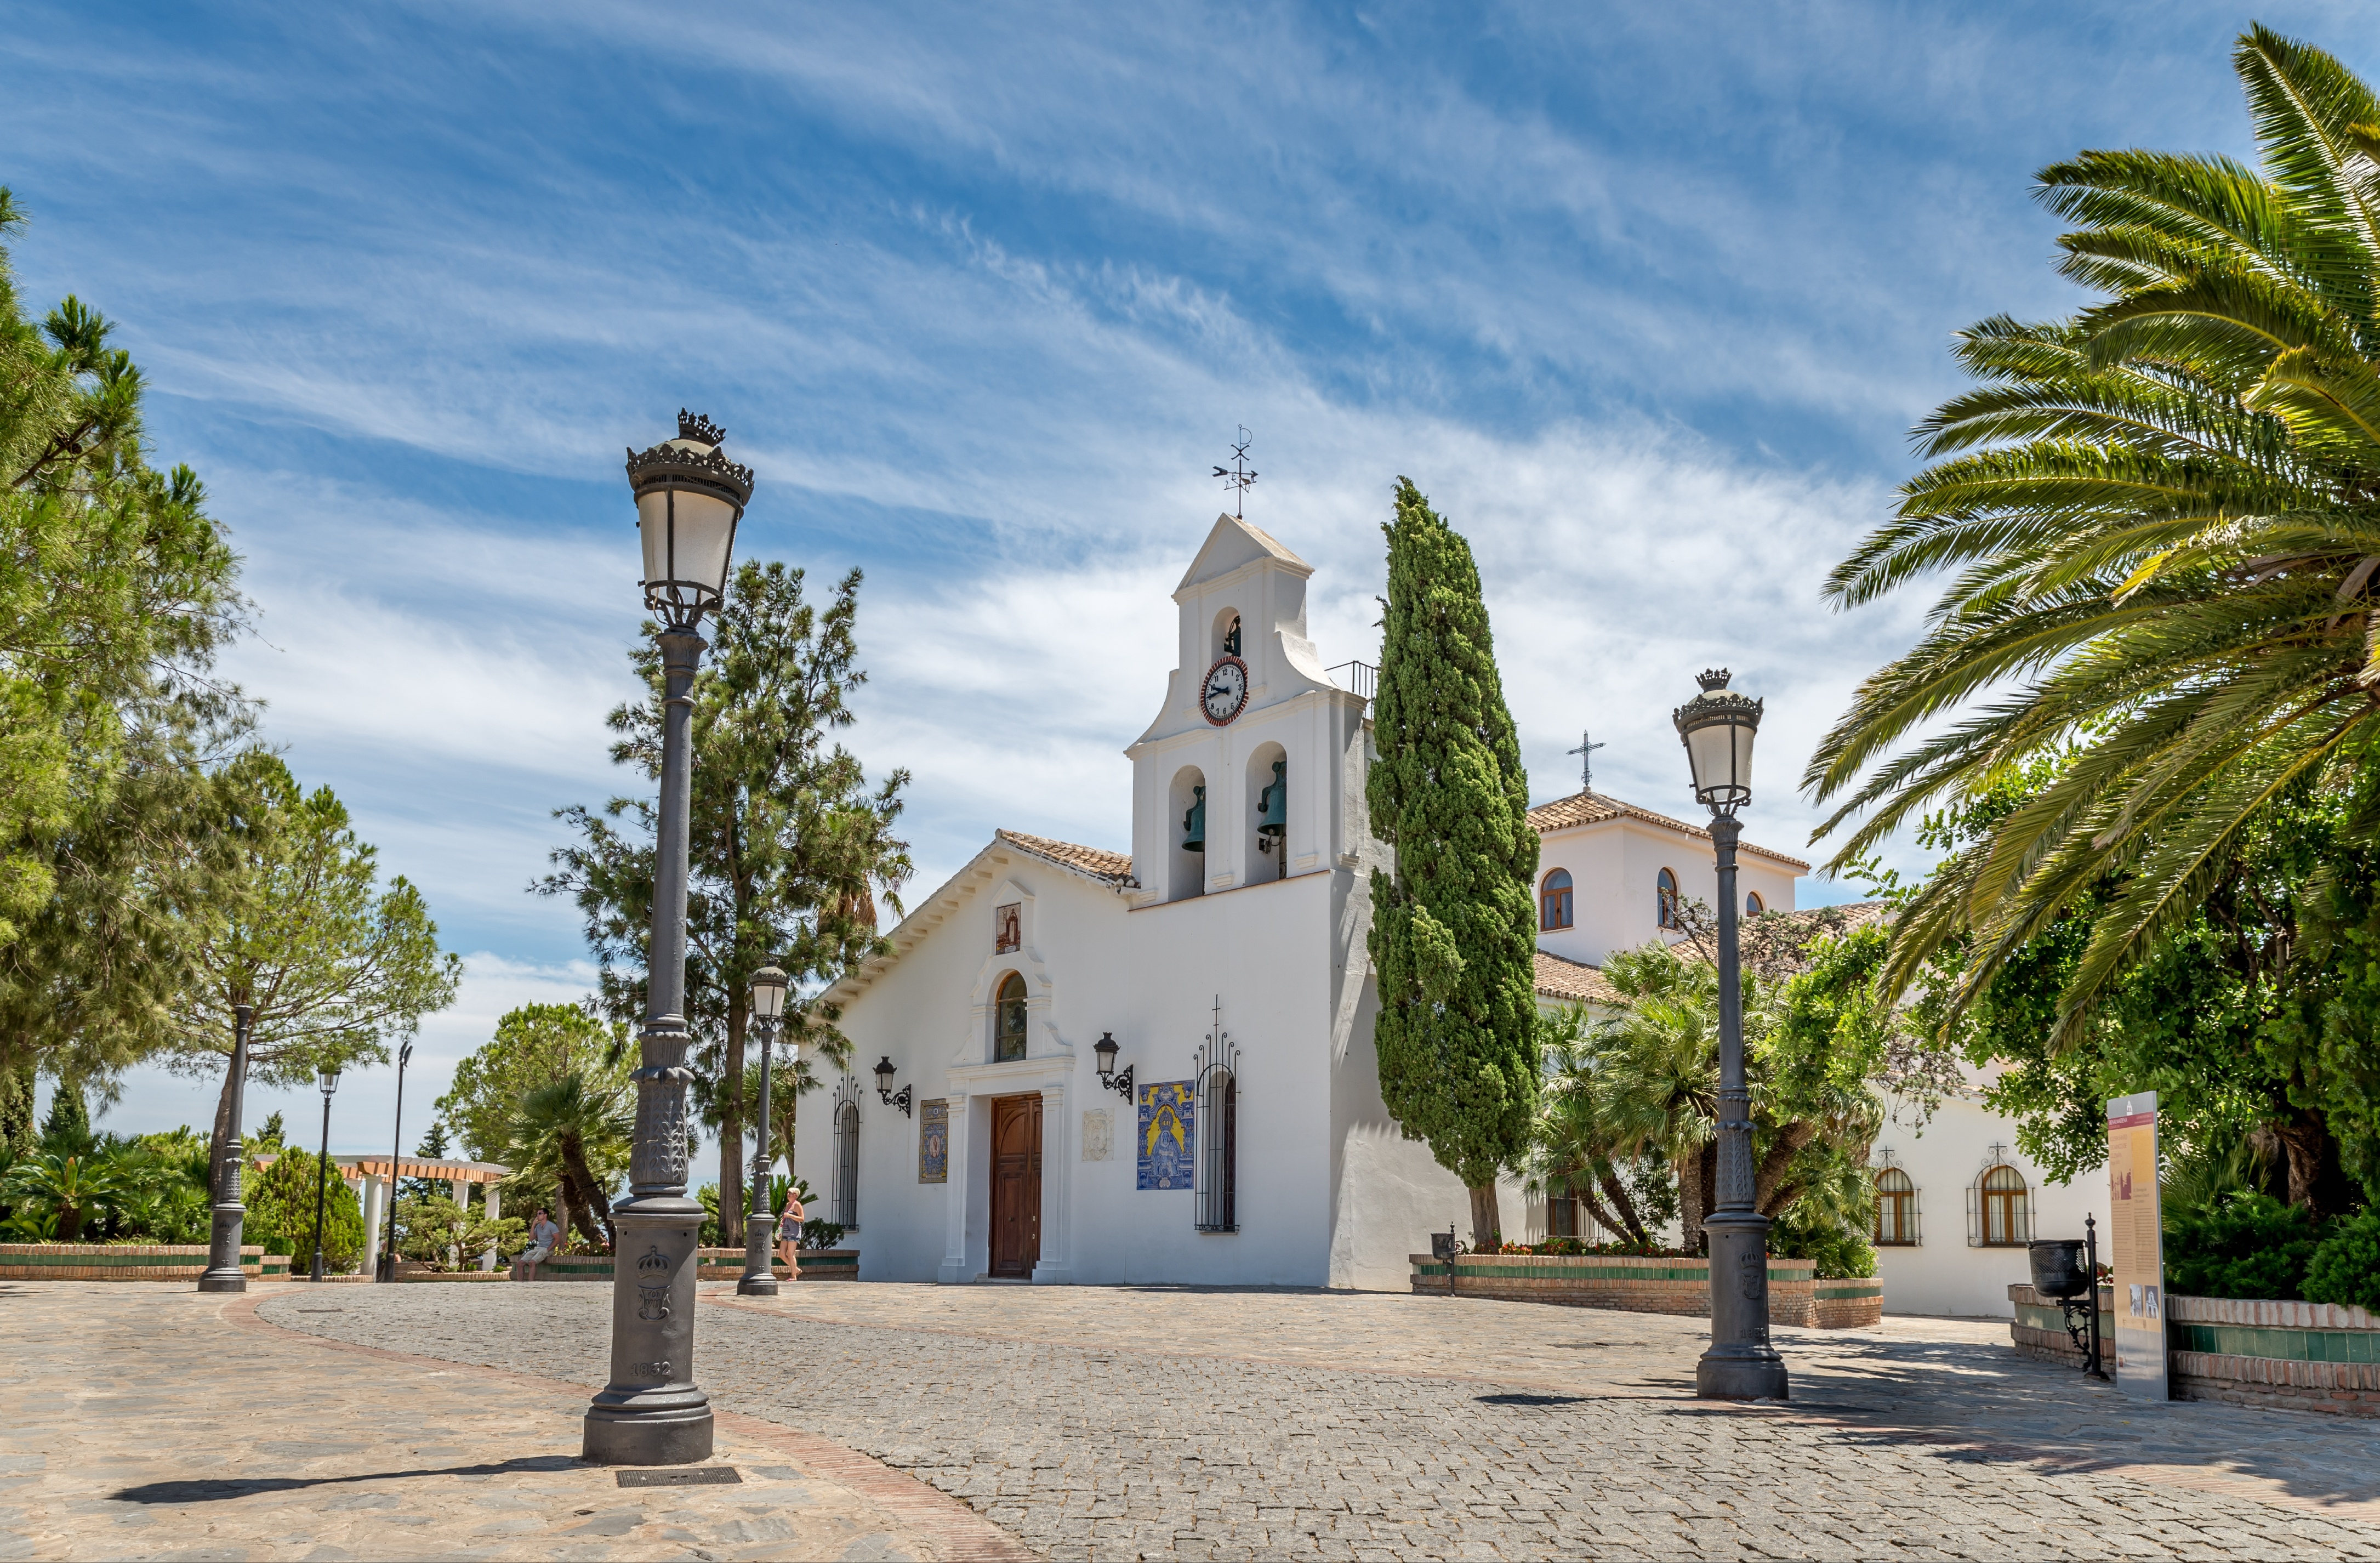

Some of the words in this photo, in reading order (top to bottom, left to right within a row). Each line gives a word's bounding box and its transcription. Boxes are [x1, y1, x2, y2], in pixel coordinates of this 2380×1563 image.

[645, 1299, 661, 1308] VII
[1741, 1327, 1766, 1338] 1832
[631, 1361, 670, 1377] 1832
